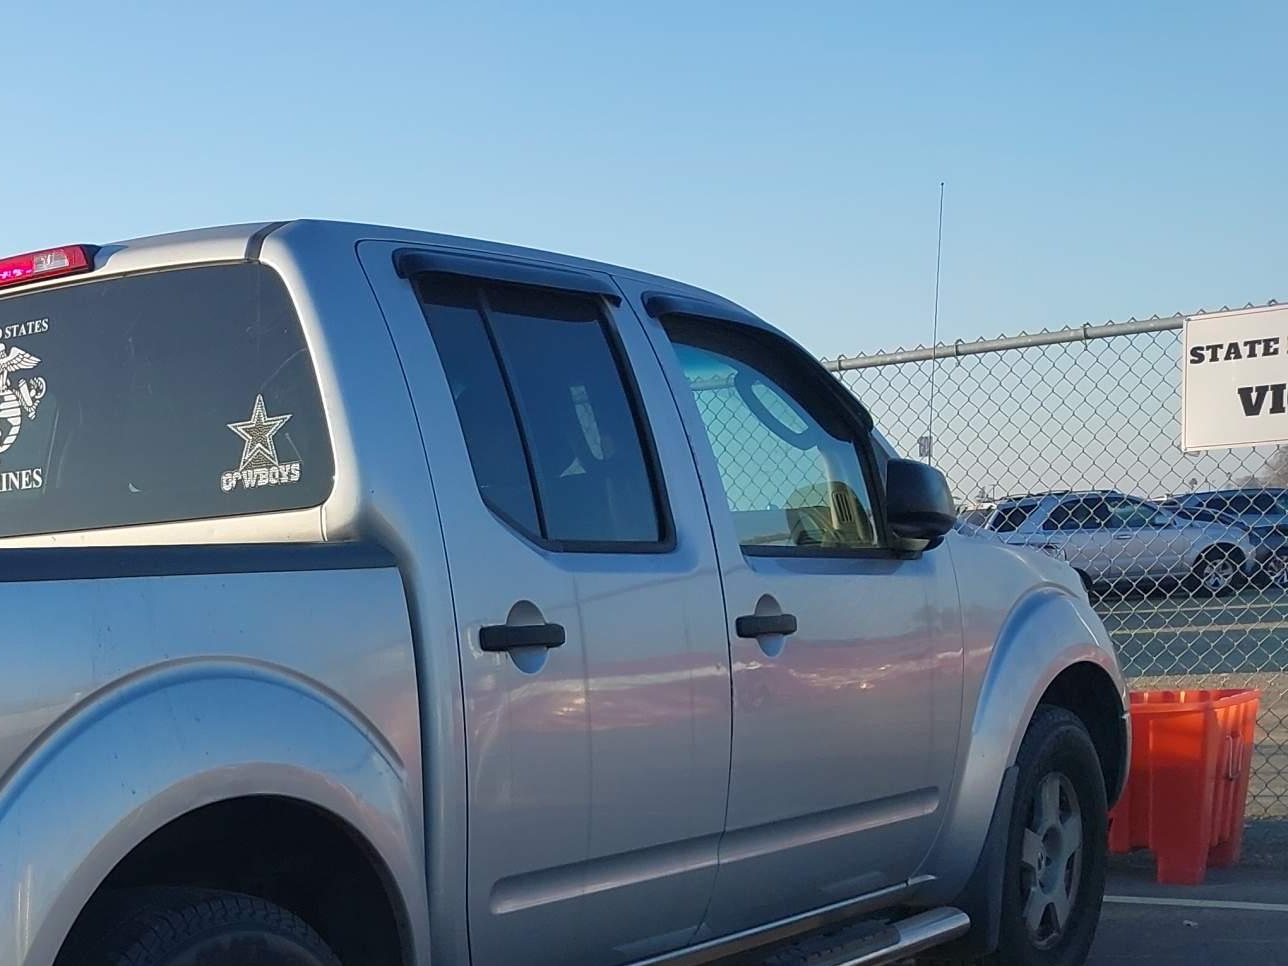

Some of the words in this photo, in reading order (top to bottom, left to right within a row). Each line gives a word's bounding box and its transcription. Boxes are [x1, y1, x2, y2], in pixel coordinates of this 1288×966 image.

[4, 317, 50, 339] STATES
[1189, 337, 1280, 365] STATE
[1237, 383, 1288, 417] VI
